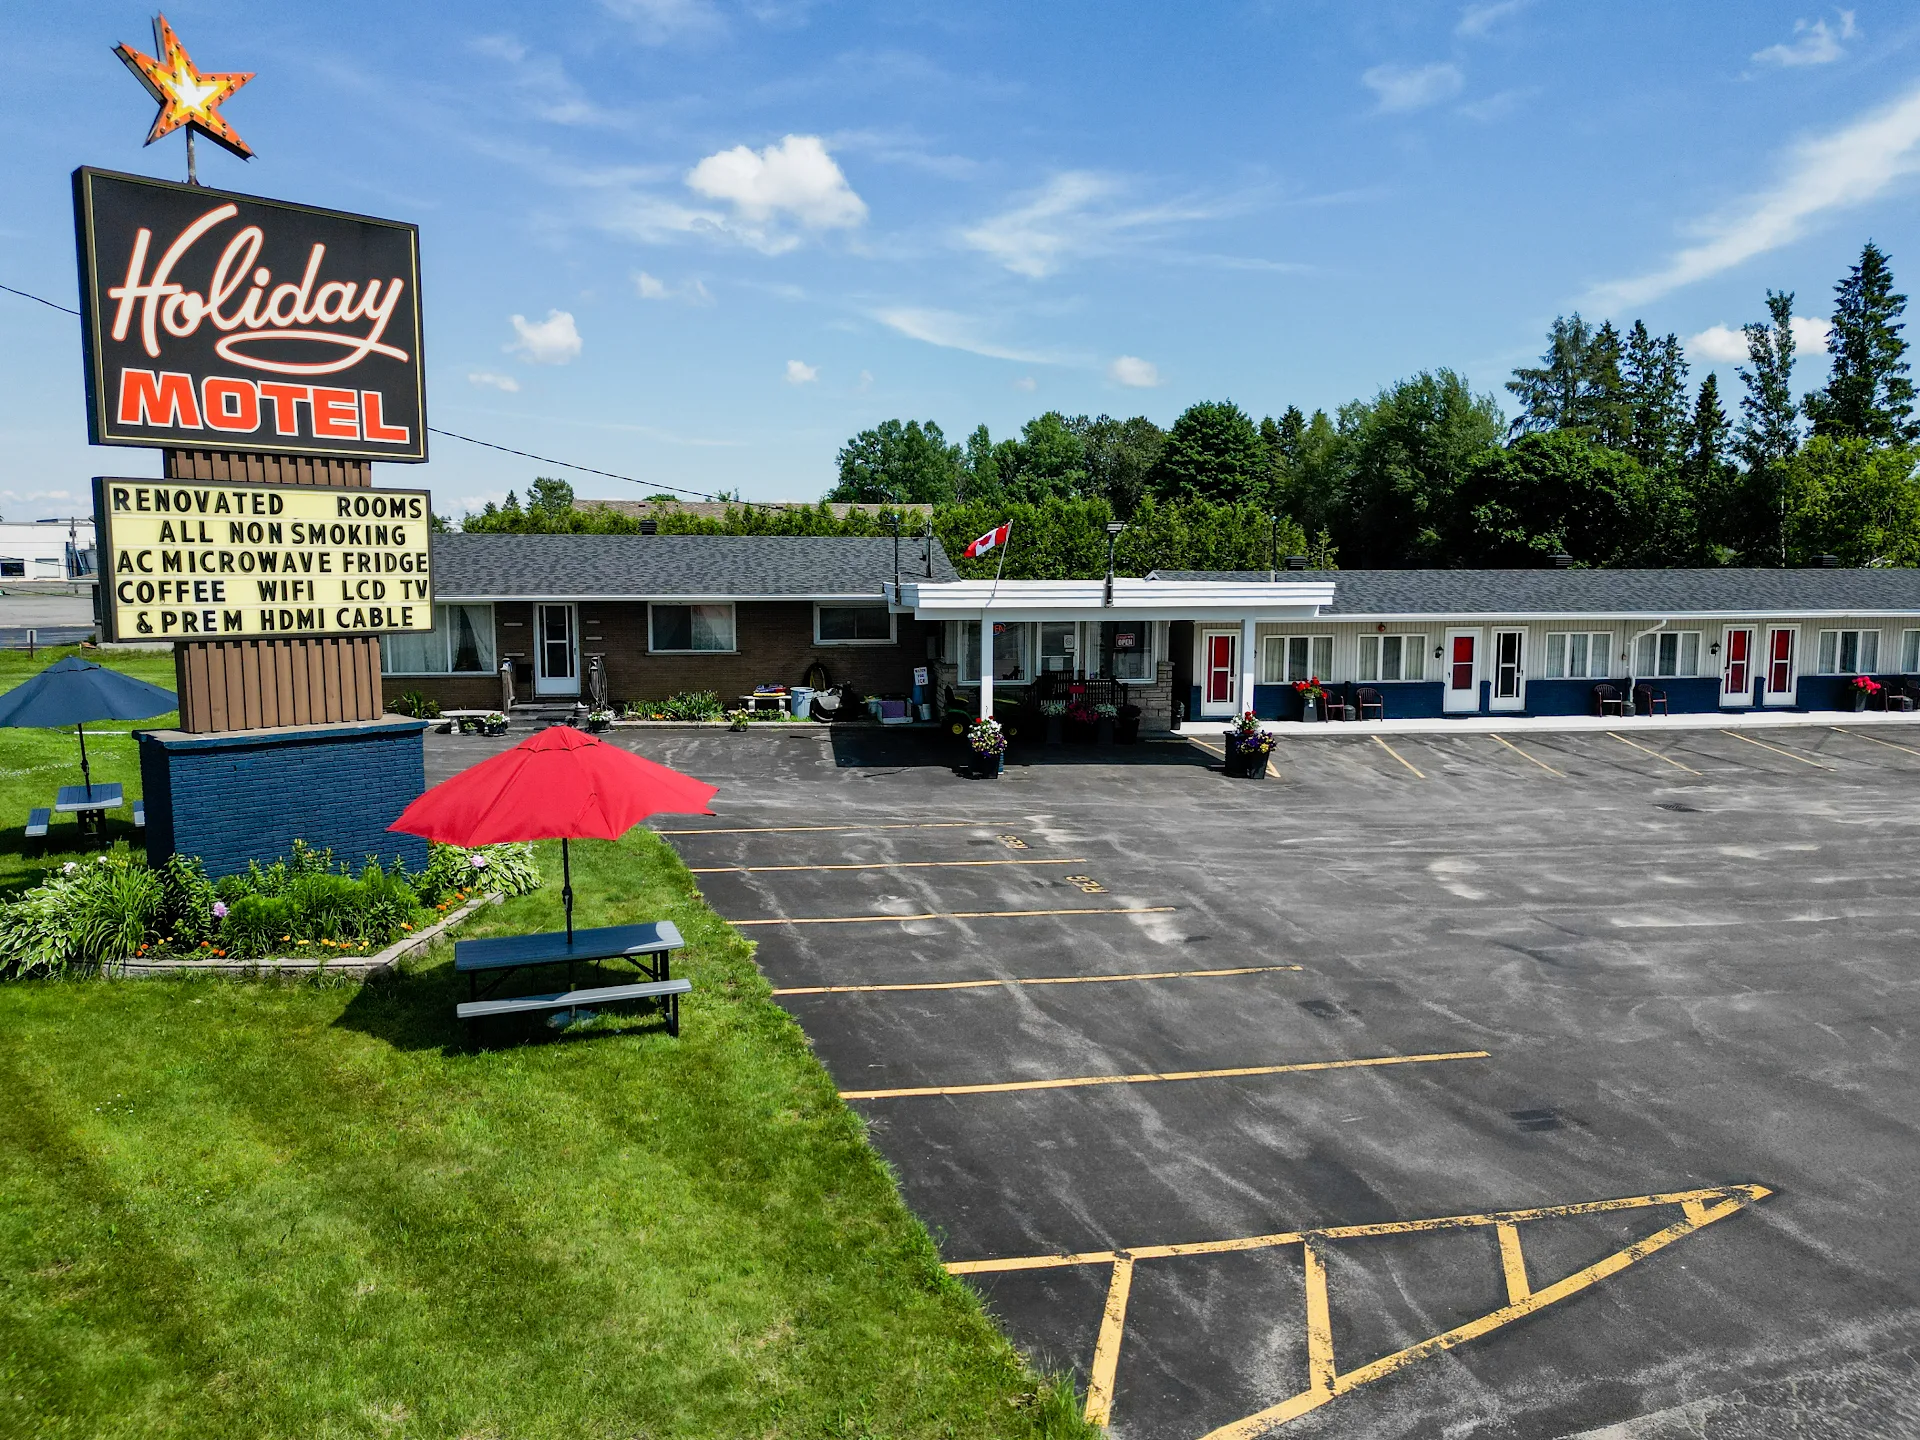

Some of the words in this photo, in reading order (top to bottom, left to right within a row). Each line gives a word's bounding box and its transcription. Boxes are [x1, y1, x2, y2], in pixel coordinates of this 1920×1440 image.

[108, 202, 409, 375] Holiday
[117, 367, 410, 445] MOTEL
[113, 487, 284, 515] RENOVATED
[336, 496, 422, 519] ROOMS
[159, 520, 213, 543] ALL
[229, 522, 283, 544] NON
[291, 523, 406, 546] SMOKING
[116, 550, 153, 573] AC
[162, 550, 332, 573] MICROWAVE
[342, 552, 428, 573] FRIDGE
[117, 580, 226, 604] COFFEE
[257, 580, 314, 601] WIFI
[342, 580, 386, 600] LCD
[400, 580, 428, 599] TV
[136, 611, 154, 634] &
[161, 610, 243, 633] PREM
[260, 608, 325, 631] HDMI
[336, 606, 413, 629] CABLE
[1117, 638, 1133, 646] OPEN
